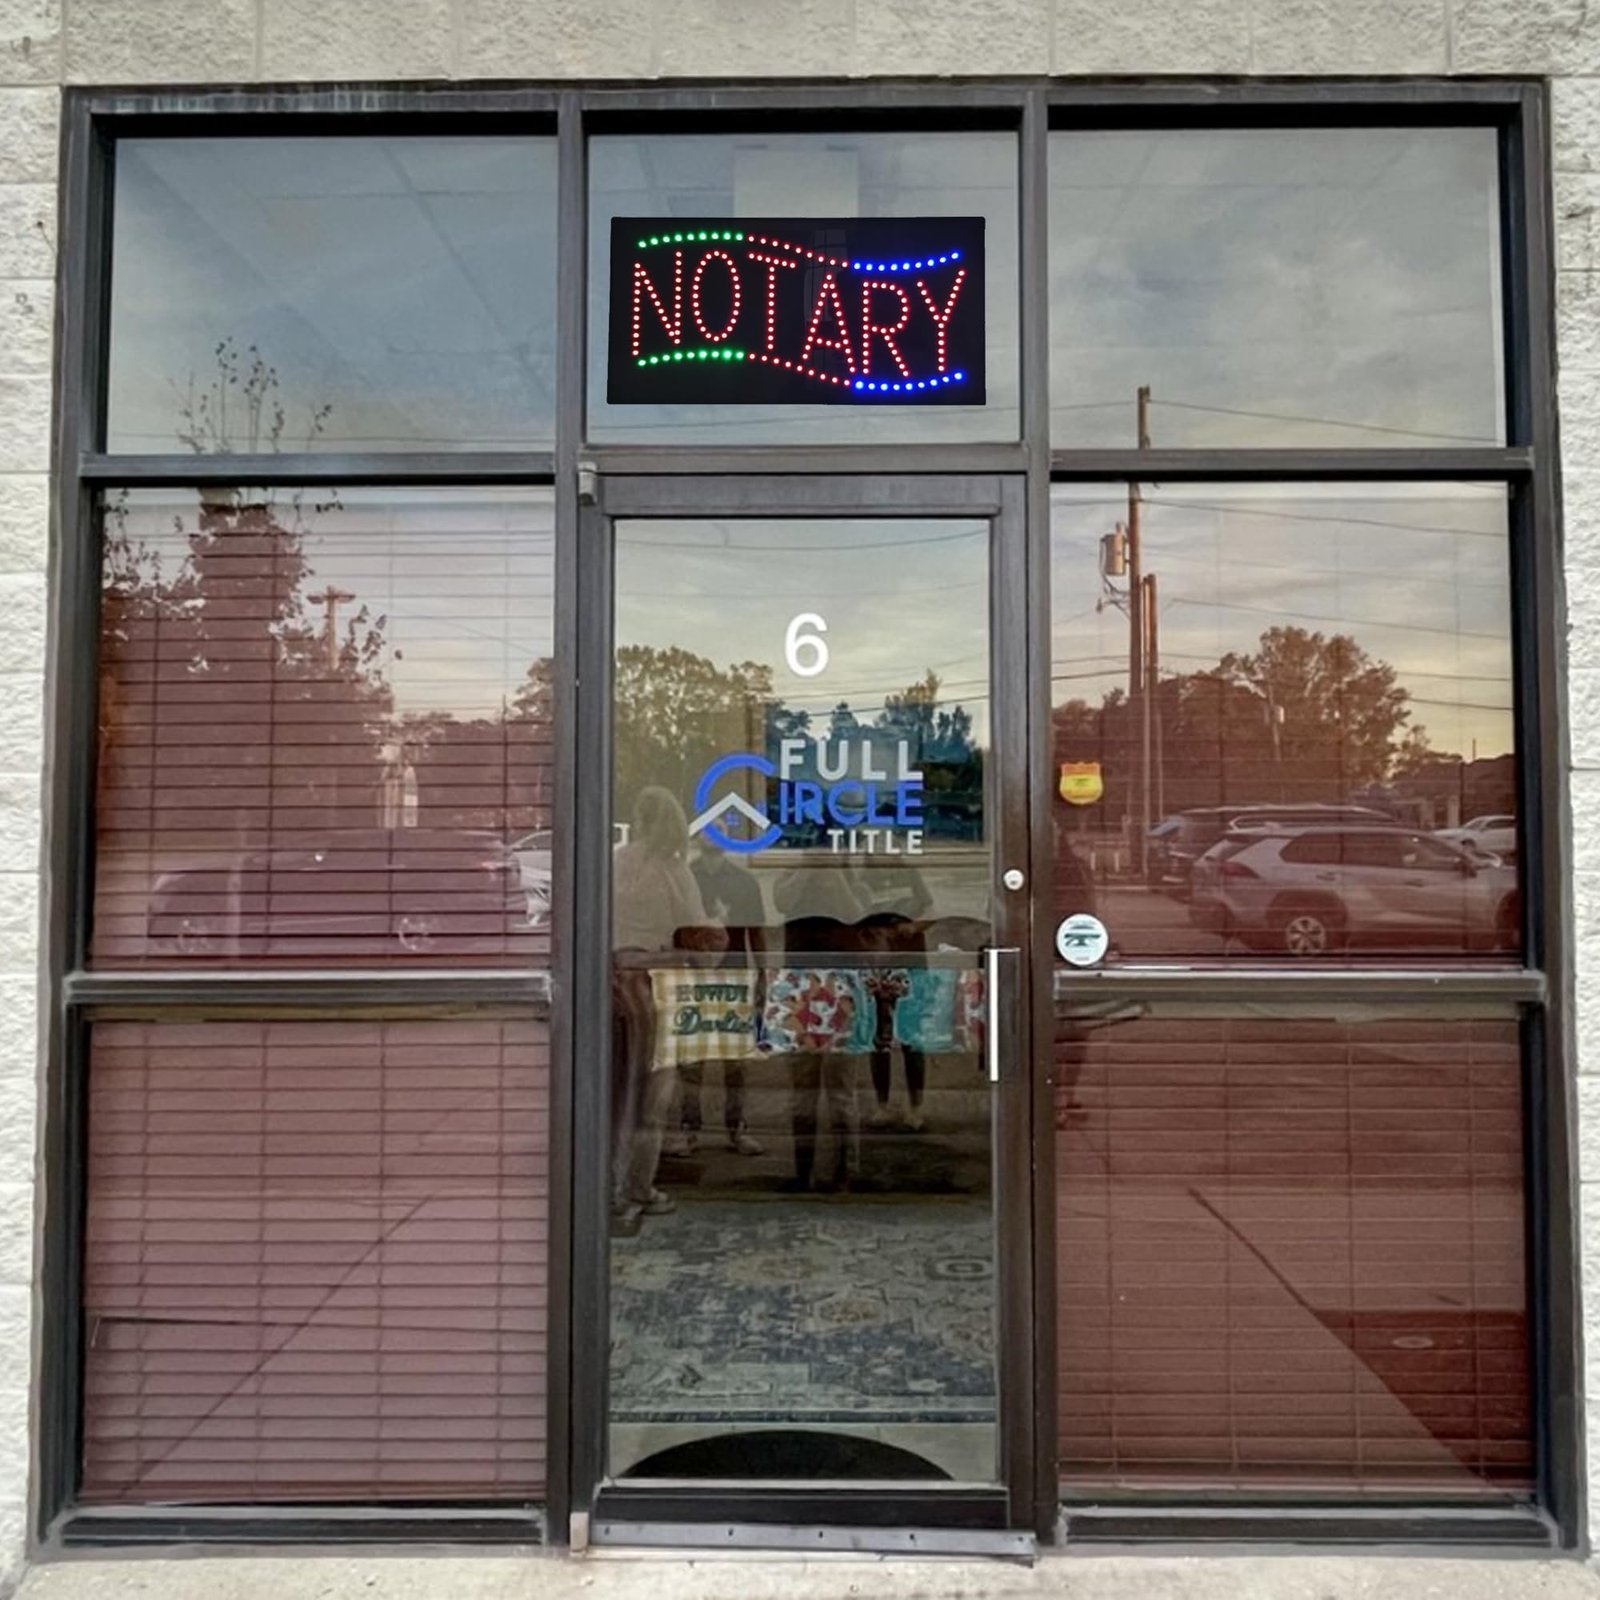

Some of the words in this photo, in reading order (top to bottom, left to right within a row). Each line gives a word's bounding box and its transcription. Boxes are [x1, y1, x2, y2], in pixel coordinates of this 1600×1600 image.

[633, 250, 965, 376] NOTARY
[784, 612, 830, 677] 6
[780, 738, 924, 782] FULL
[827, 829, 924, 855] TITLE
